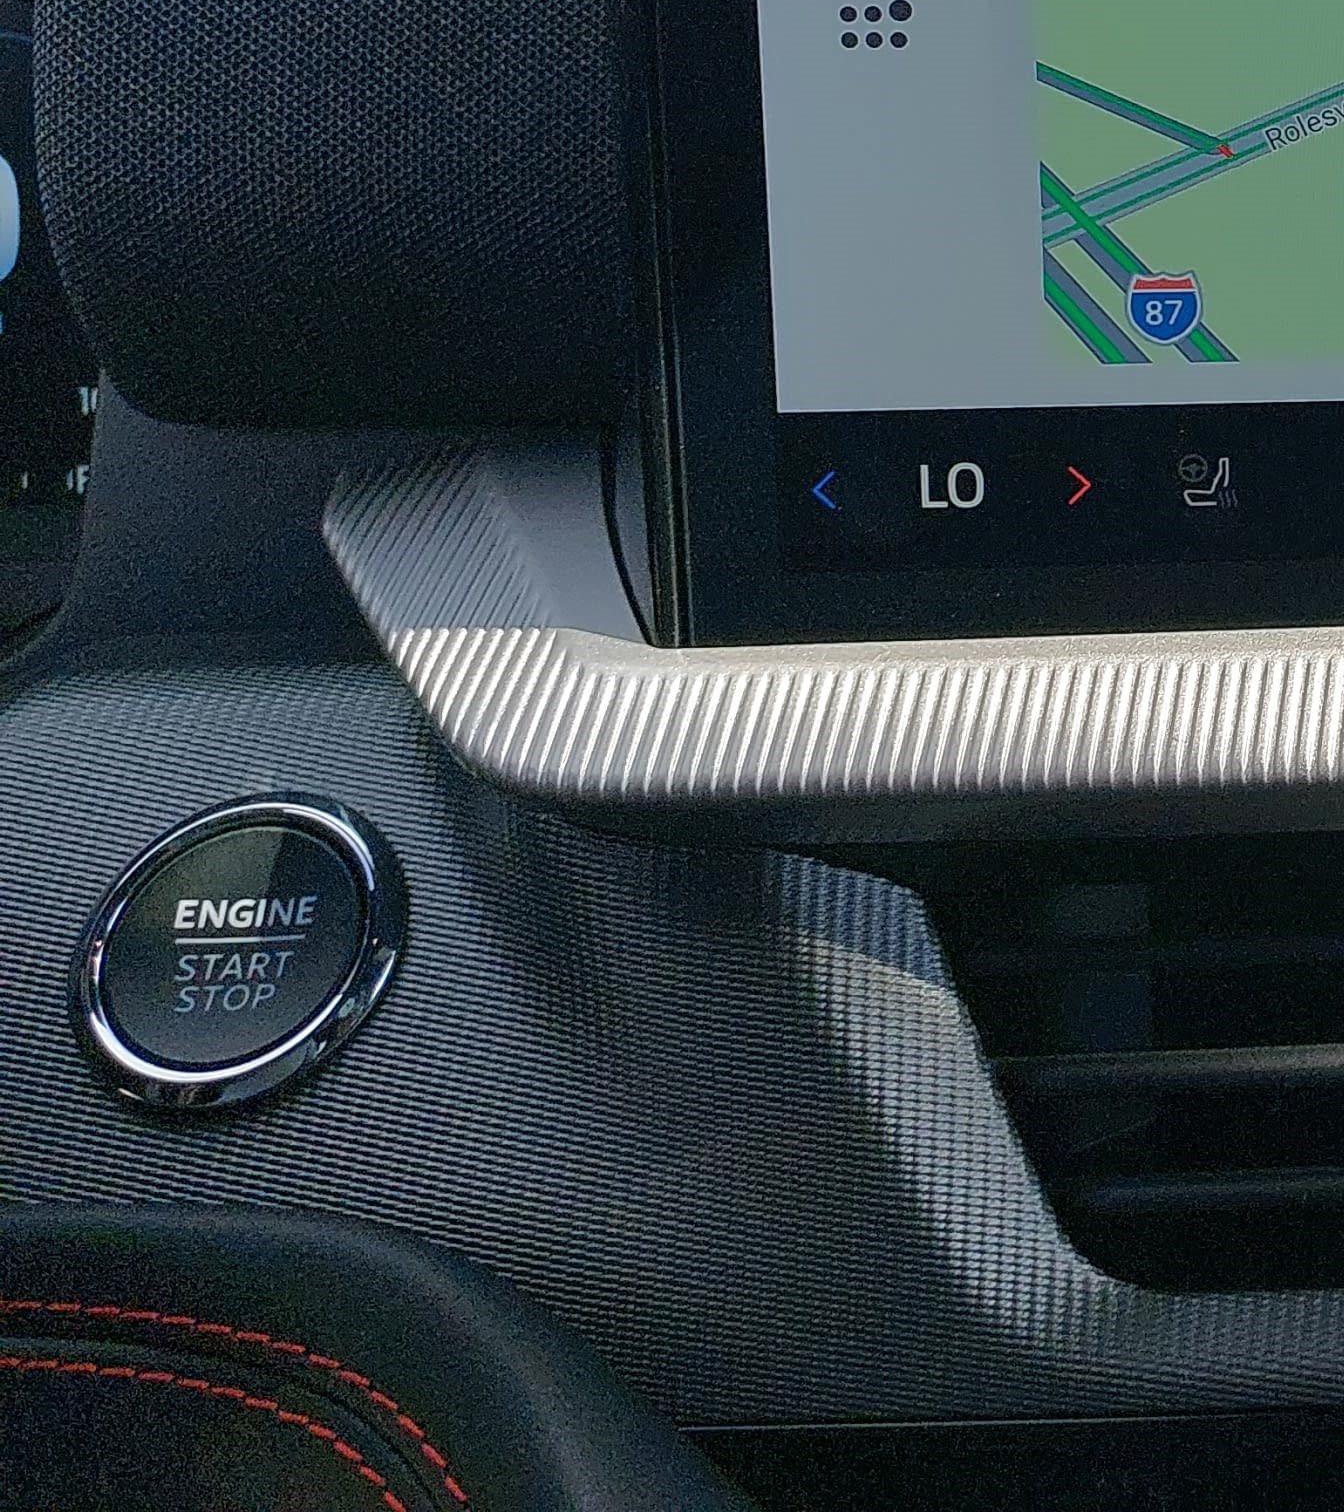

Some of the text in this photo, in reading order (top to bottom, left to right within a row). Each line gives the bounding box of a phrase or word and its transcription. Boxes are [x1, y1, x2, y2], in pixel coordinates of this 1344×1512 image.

[1145, 299, 1183, 326] 87
[919, 461, 986, 509] LO
[173, 894, 319, 930] ENGINE
[174, 950, 295, 982] START
[174, 982, 276, 1013] STOP
